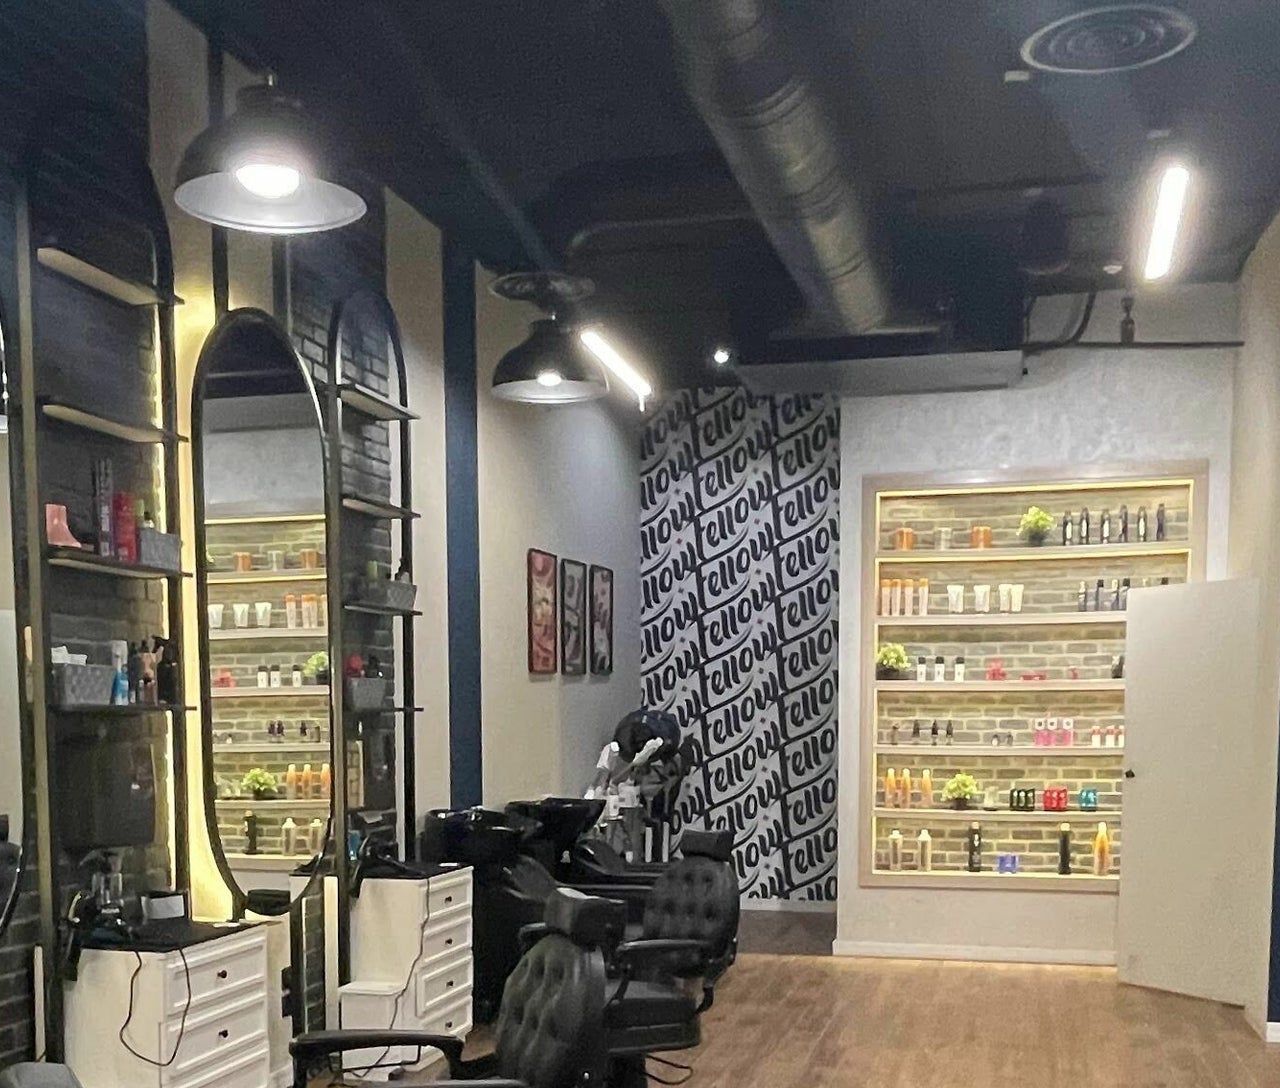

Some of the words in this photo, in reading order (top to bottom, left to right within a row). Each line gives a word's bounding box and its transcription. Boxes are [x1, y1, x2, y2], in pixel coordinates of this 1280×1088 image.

[683, 421, 771, 511] Fellow
[684, 471, 772, 561] Fellow
[685, 522, 773, 611] Fellow
[640, 592, 699, 664] llow
[687, 572, 775, 660] Fellow
[767, 620, 838, 692] Fello
[688, 622, 777, 708] Fellow
[769, 670, 838, 740] Fello
[691, 672, 778, 757] Fellow
[770, 722, 838, 790] Fello
[693, 721, 780, 806] Fellow
[771, 771, 837, 838] Fello
[772, 824, 838, 888] Fello
